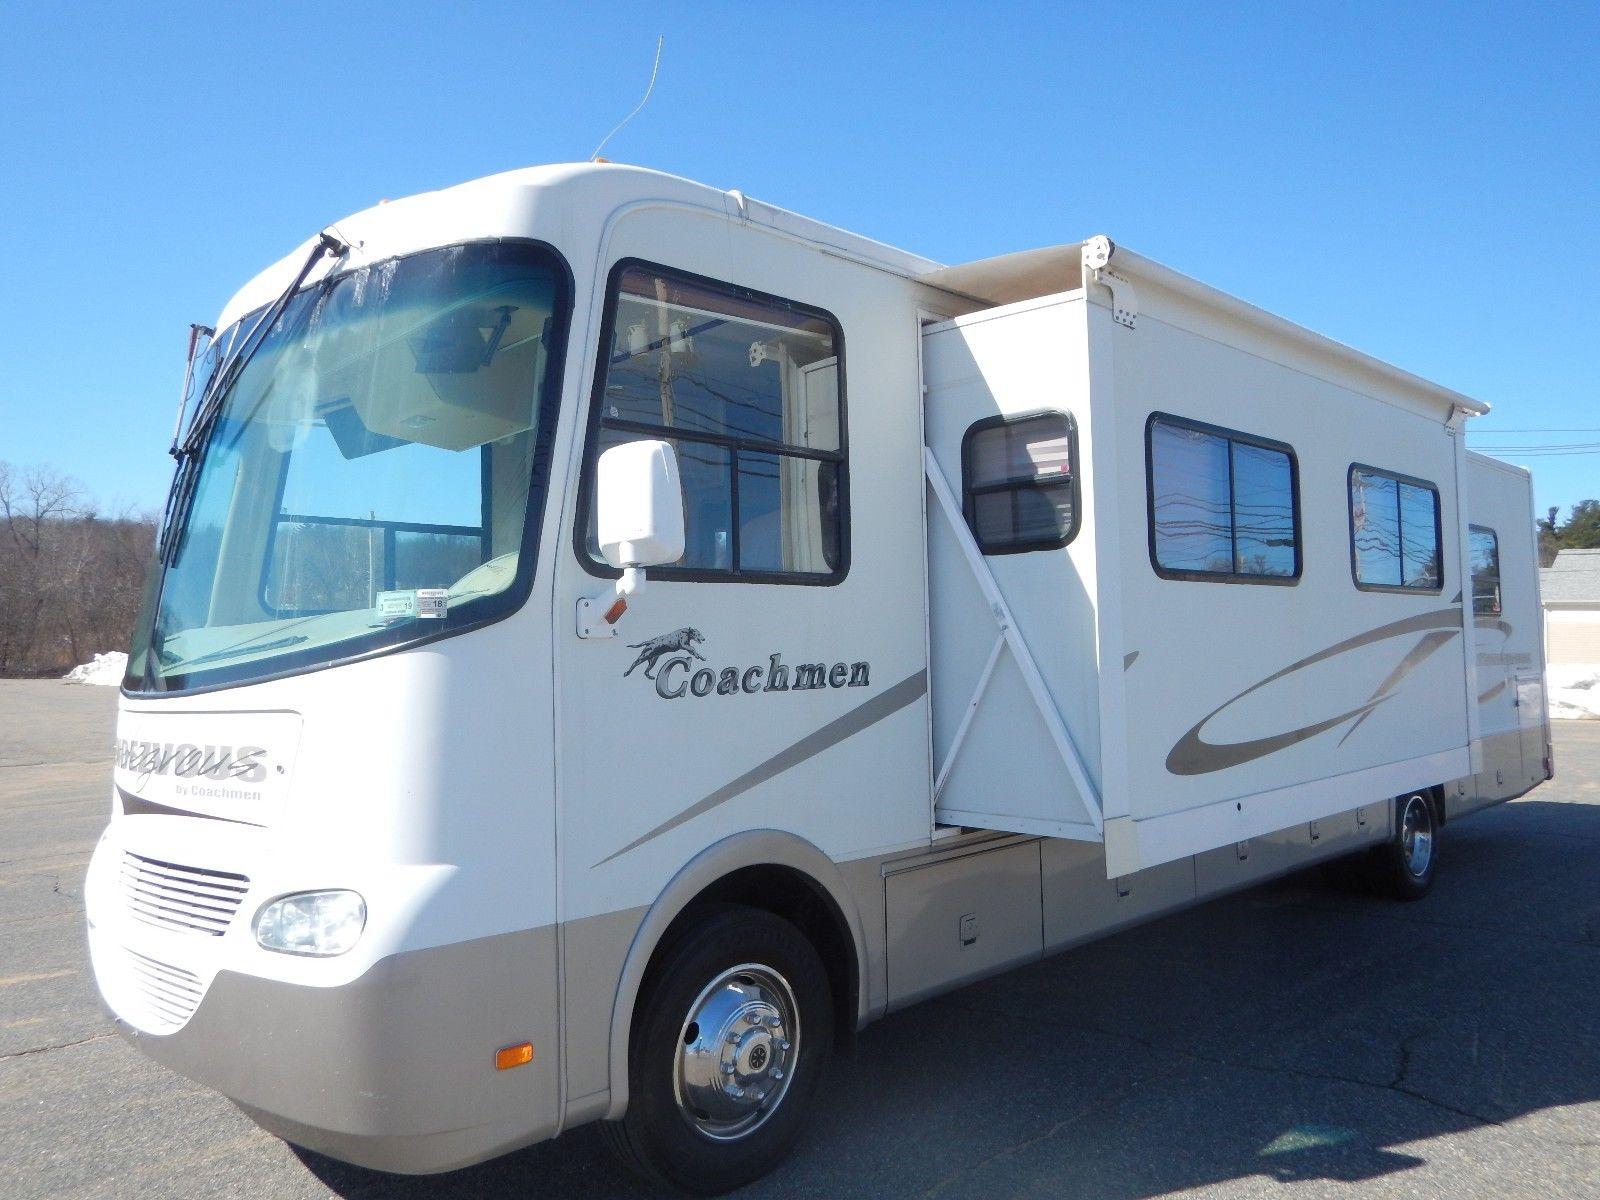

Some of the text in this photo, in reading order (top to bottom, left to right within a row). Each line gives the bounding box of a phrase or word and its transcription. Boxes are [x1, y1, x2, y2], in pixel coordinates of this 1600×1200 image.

[404, 601, 413, 610] 19
[433, 600, 443, 608] 18
[655, 653, 871, 700] Coachmen
[175, 785, 261, 801] by Coachmen
